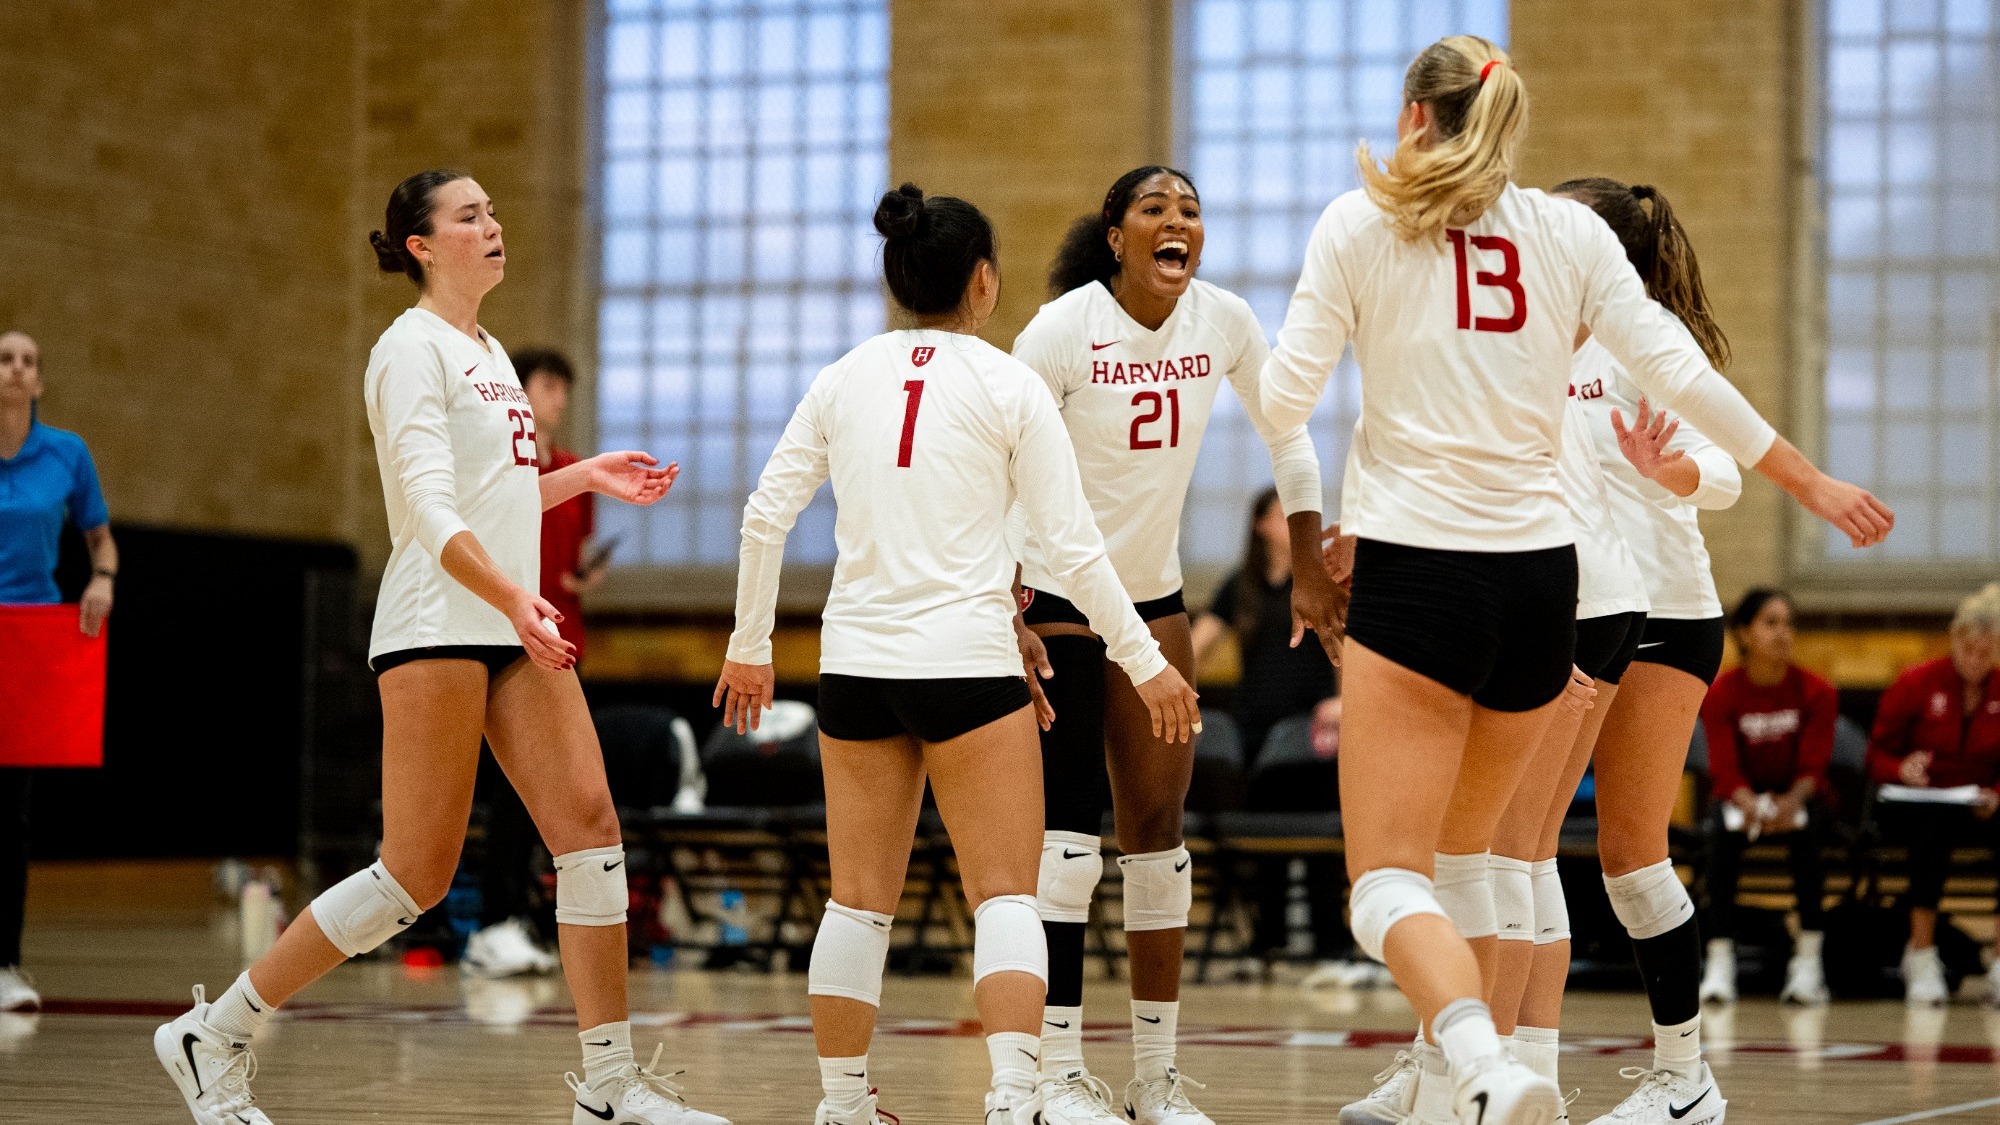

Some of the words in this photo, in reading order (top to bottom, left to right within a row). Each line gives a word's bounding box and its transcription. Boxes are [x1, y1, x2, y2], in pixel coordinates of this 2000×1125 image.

[1446, 228, 1527, 333] 13
[914, 348, 931, 362] H
[1091, 353, 1211, 385] HARVARD
[473, 381, 530, 406] HARVAR
[507, 408, 538, 468] 23
[896, 380, 925, 468] 1
[1129, 388, 1180, 451] 21
[1067, 1070, 1082, 1080] NIKE
